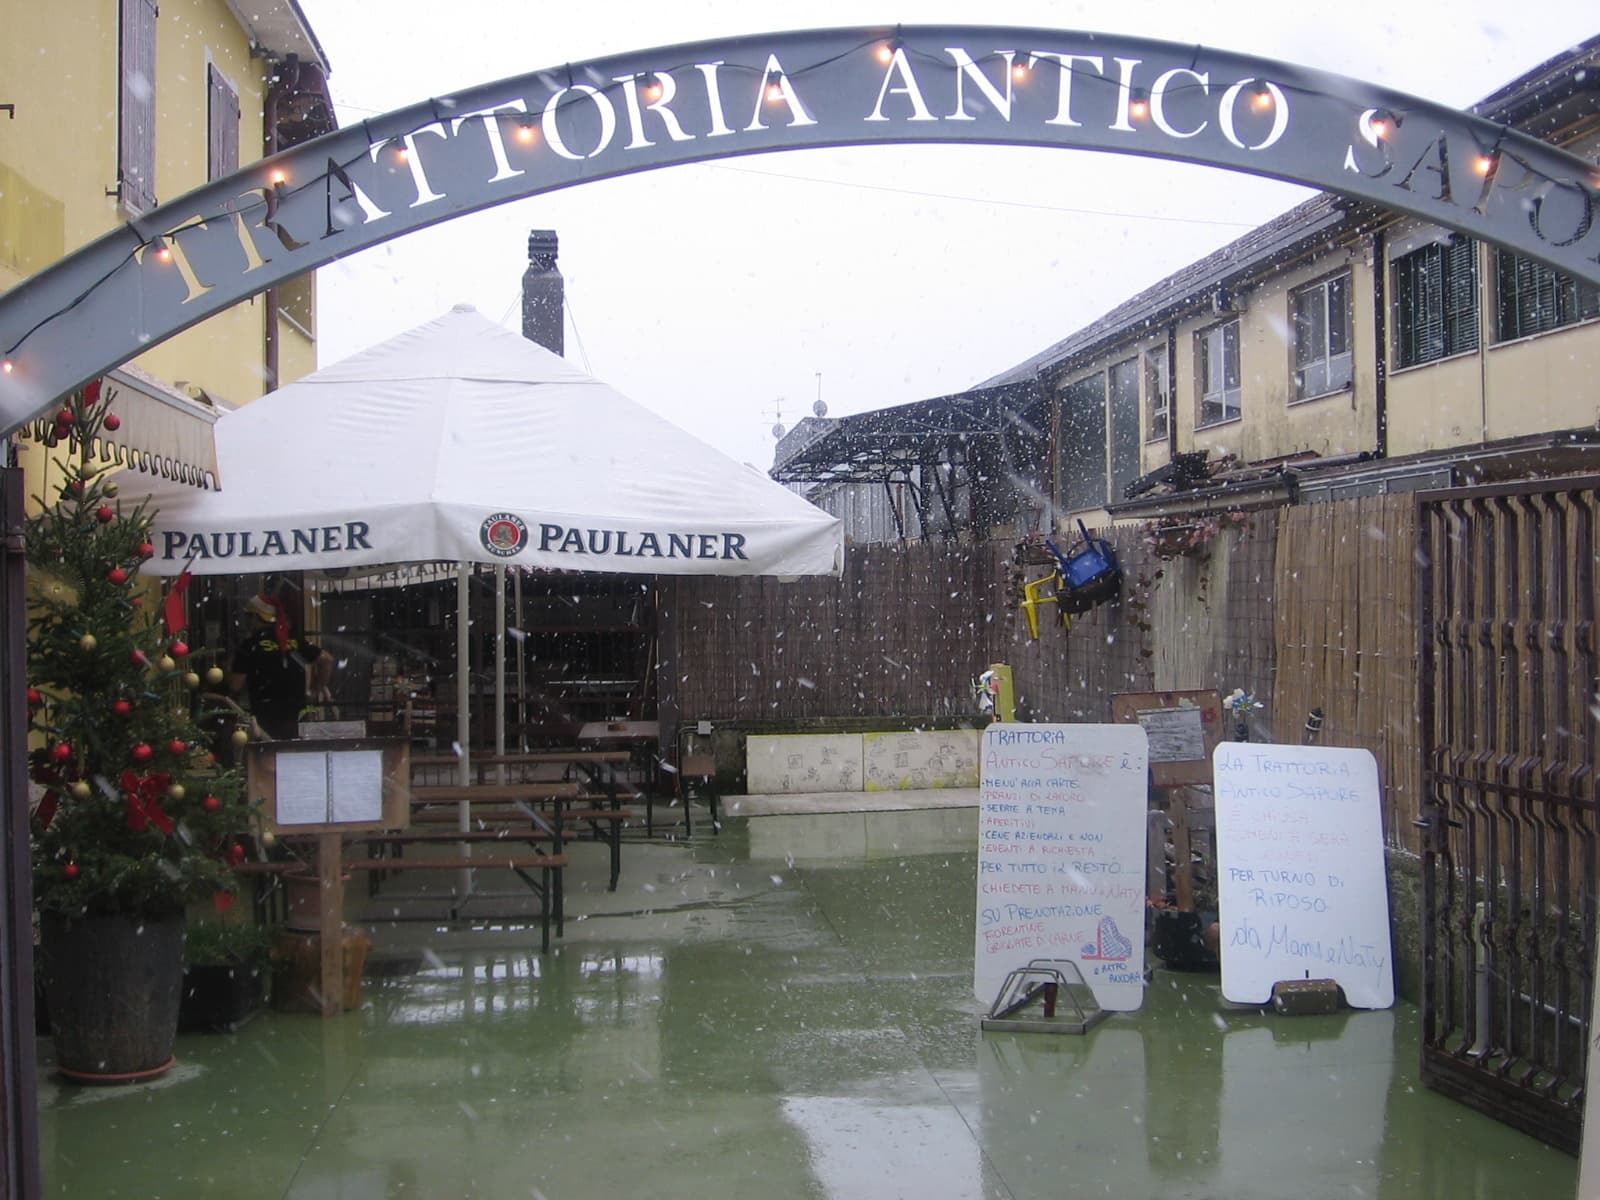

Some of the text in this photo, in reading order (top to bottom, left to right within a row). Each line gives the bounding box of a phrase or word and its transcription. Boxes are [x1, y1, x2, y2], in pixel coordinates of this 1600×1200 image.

[133, 53, 818, 304] TRATTORIA
[864, 46, 1291, 150] ANTICO
[162, 521, 373, 560] PAULANER
[538, 523, 749, 560] PAULANER
[980, 862, 1003, 875] PER
[1007, 863, 1047, 874] TUTTO
[1229, 867, 1256, 882] PER
[1258, 870, 1316, 887] TURNO
[1045, 885, 1055, 895] A
[982, 909, 1001, 926] SU
